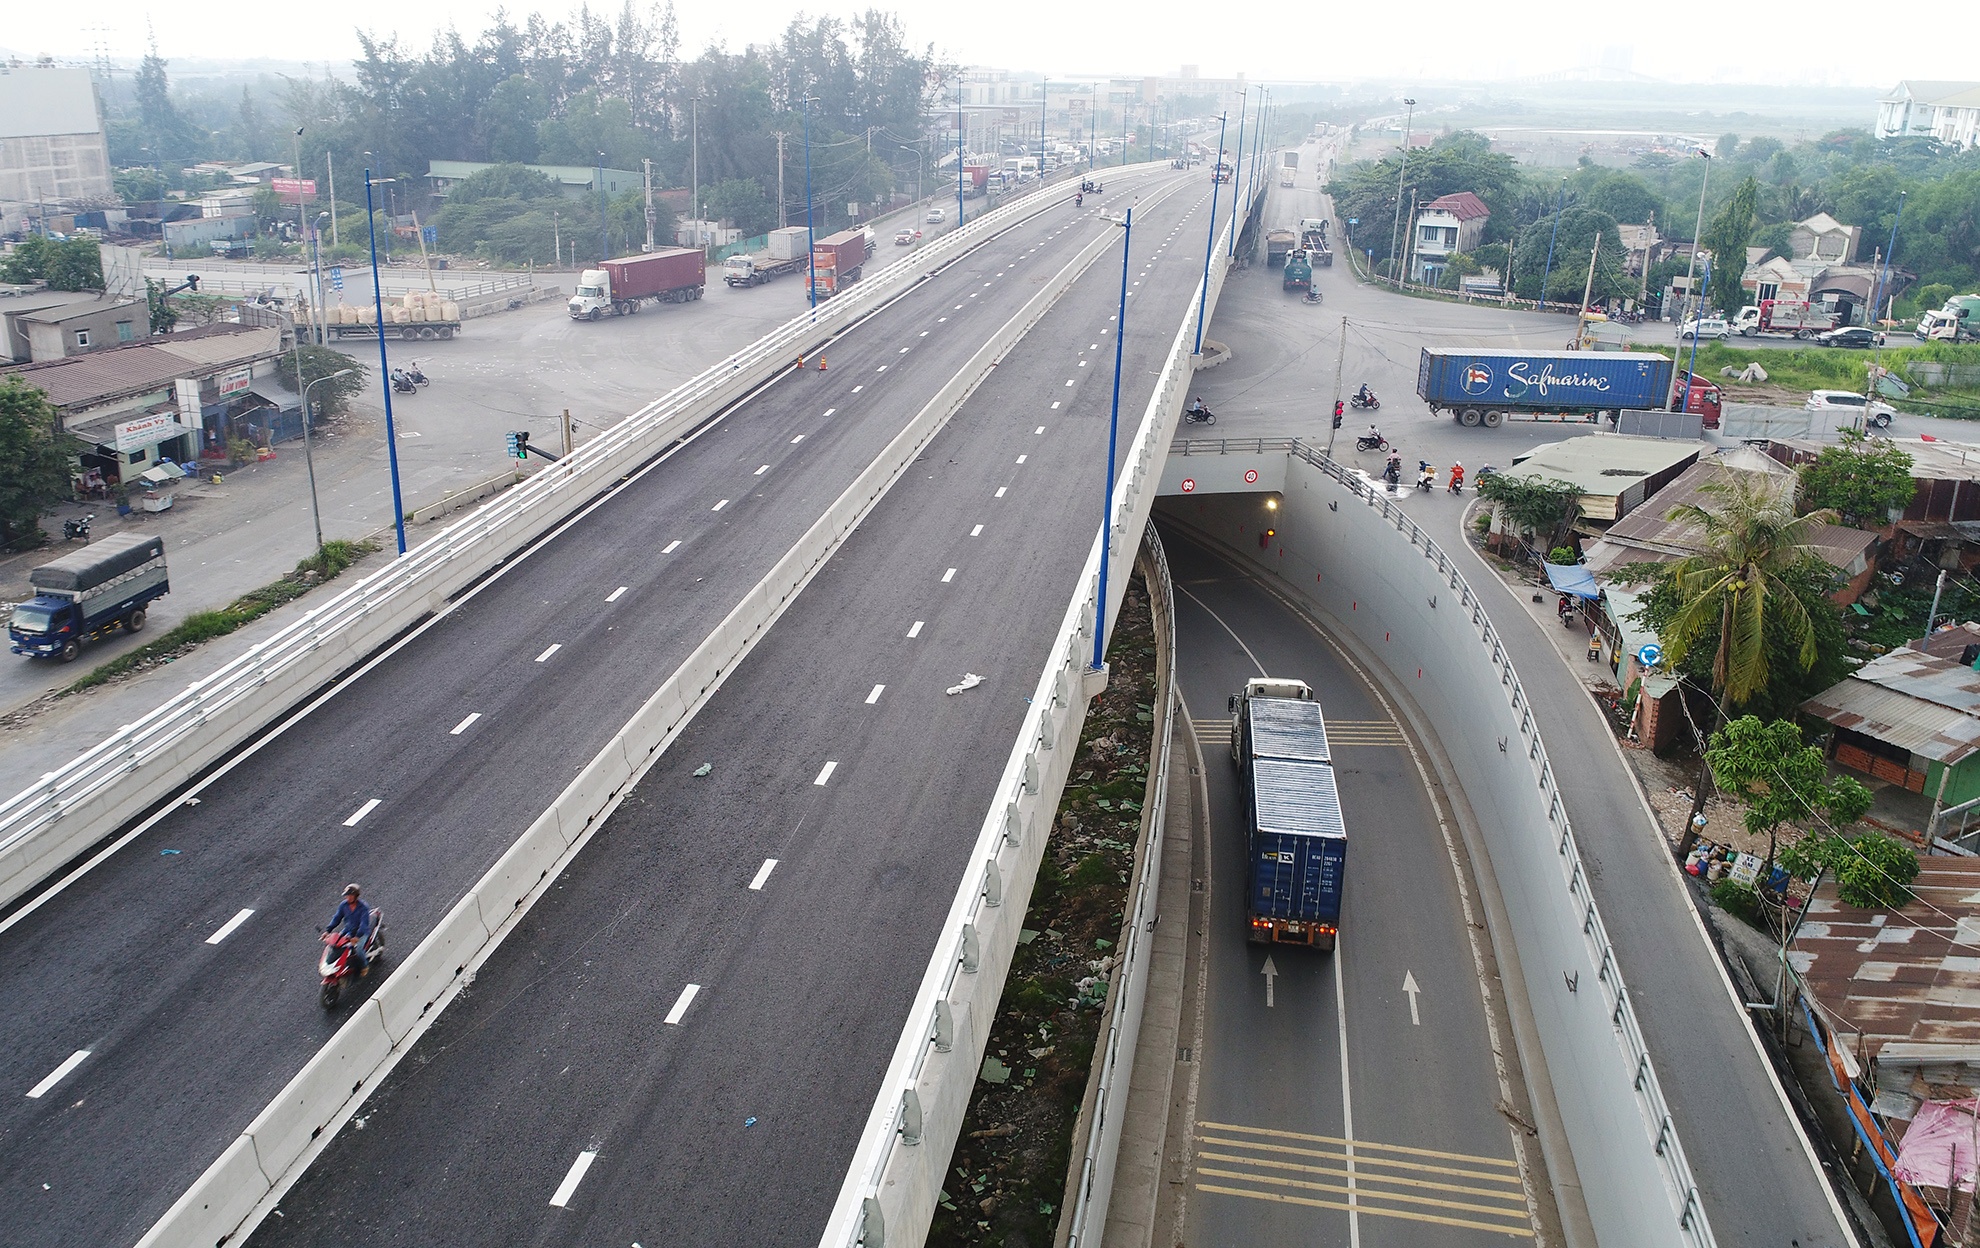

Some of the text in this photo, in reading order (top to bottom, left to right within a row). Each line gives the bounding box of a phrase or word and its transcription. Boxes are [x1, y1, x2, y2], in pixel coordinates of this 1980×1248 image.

[1503, 362, 1610, 399] Safmarine
[126, 421, 153, 433] Khánh
[154, 418, 165, 426] Vy
